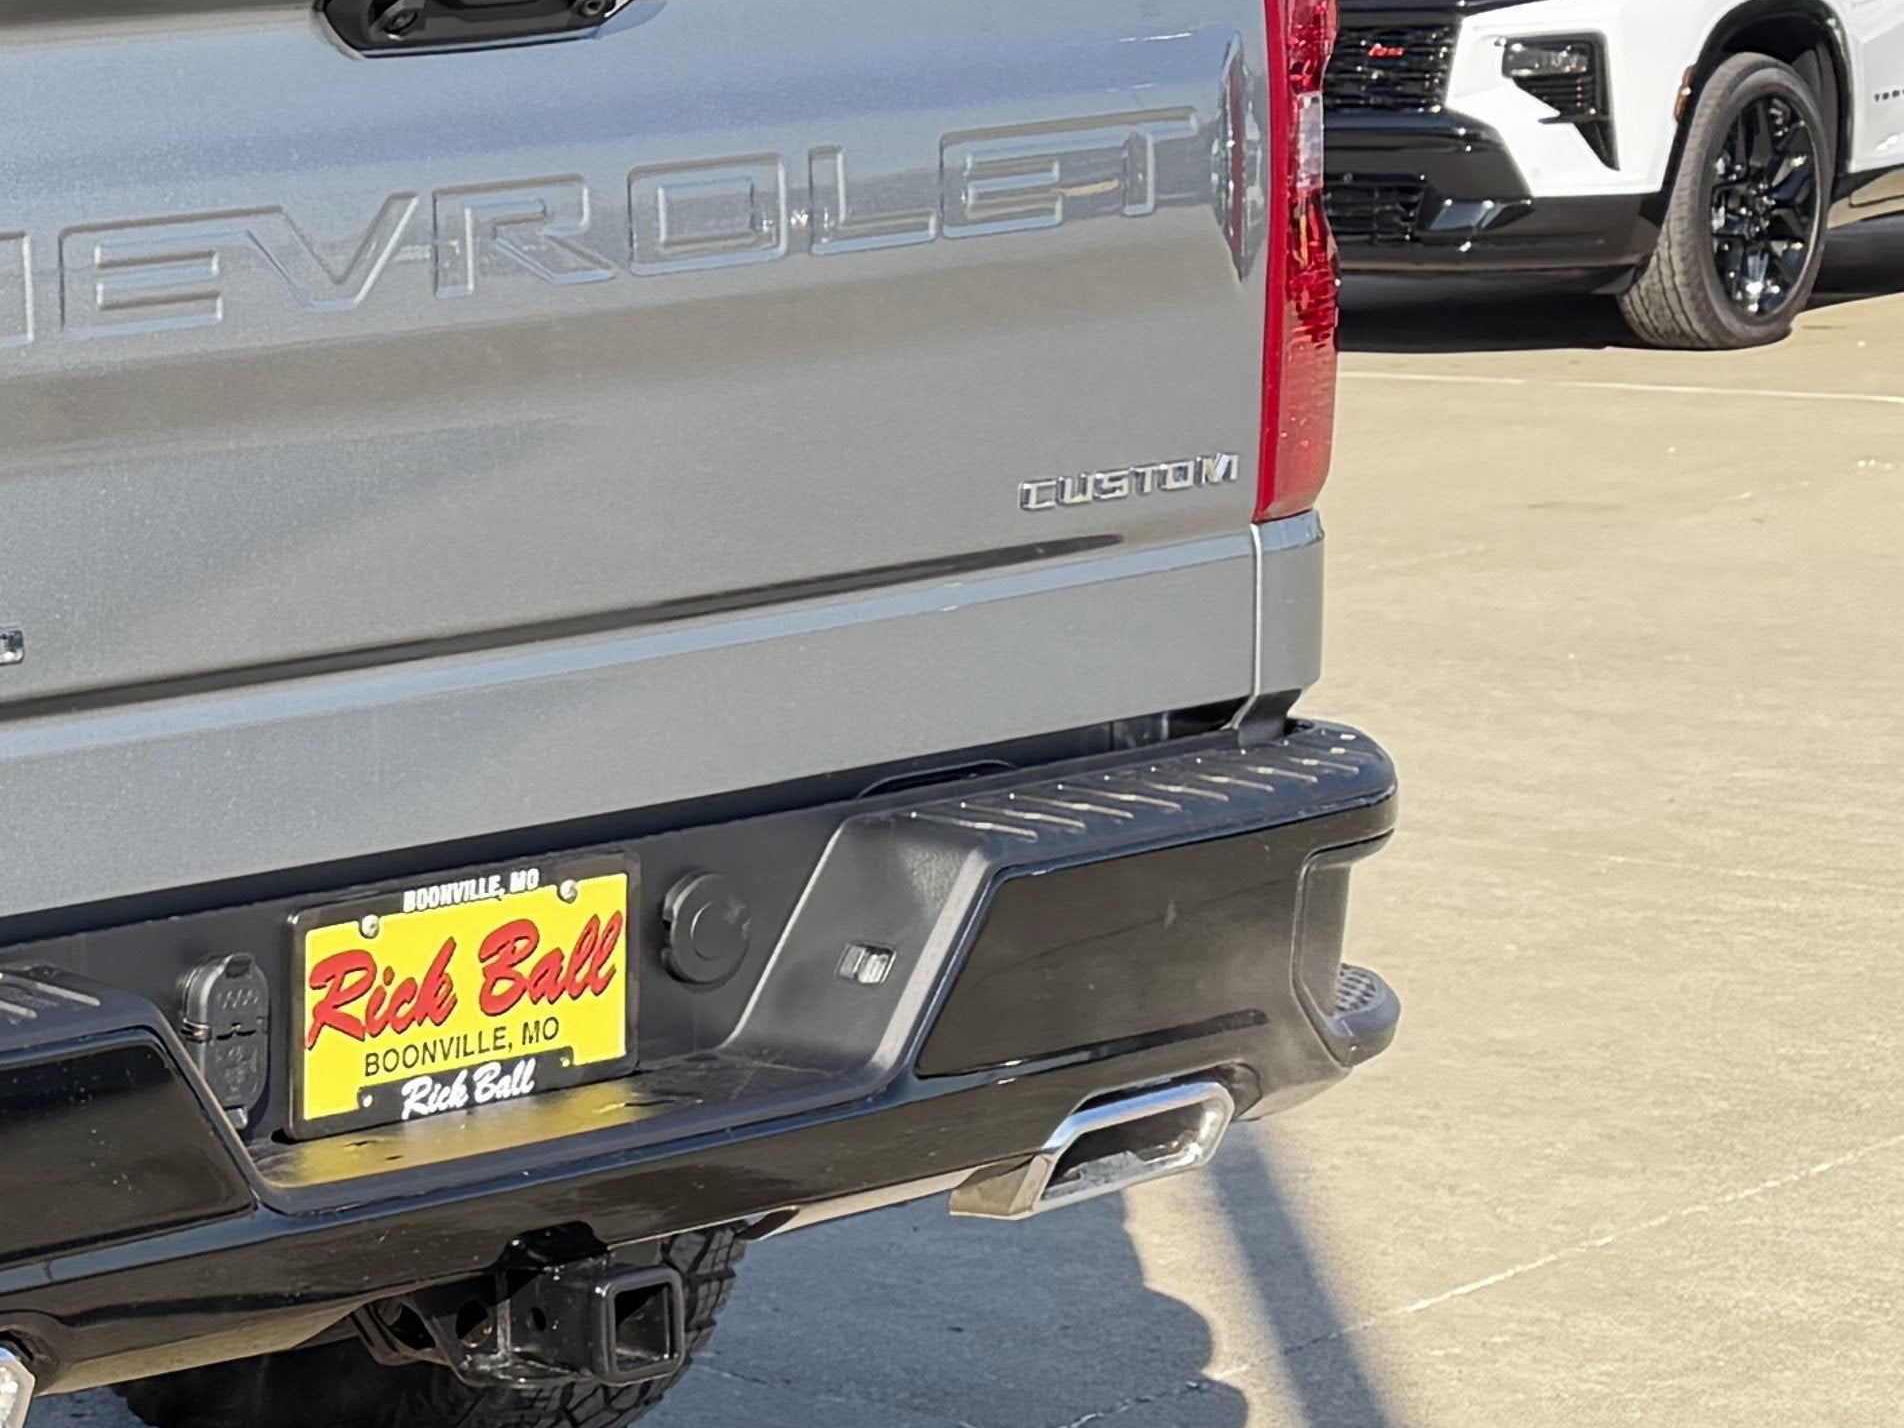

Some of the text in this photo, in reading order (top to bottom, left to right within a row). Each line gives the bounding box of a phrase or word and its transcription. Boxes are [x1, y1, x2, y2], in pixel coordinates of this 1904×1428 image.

[1017, 452, 1240, 511] CUSTOM
[402, 868, 540, 913] BOONVILLE, MO
[304, 910, 624, 1050] Rick Ball
[364, 1015, 560, 1078] BOONVILLE, MO
[400, 1058, 537, 1121] Rick Ball
